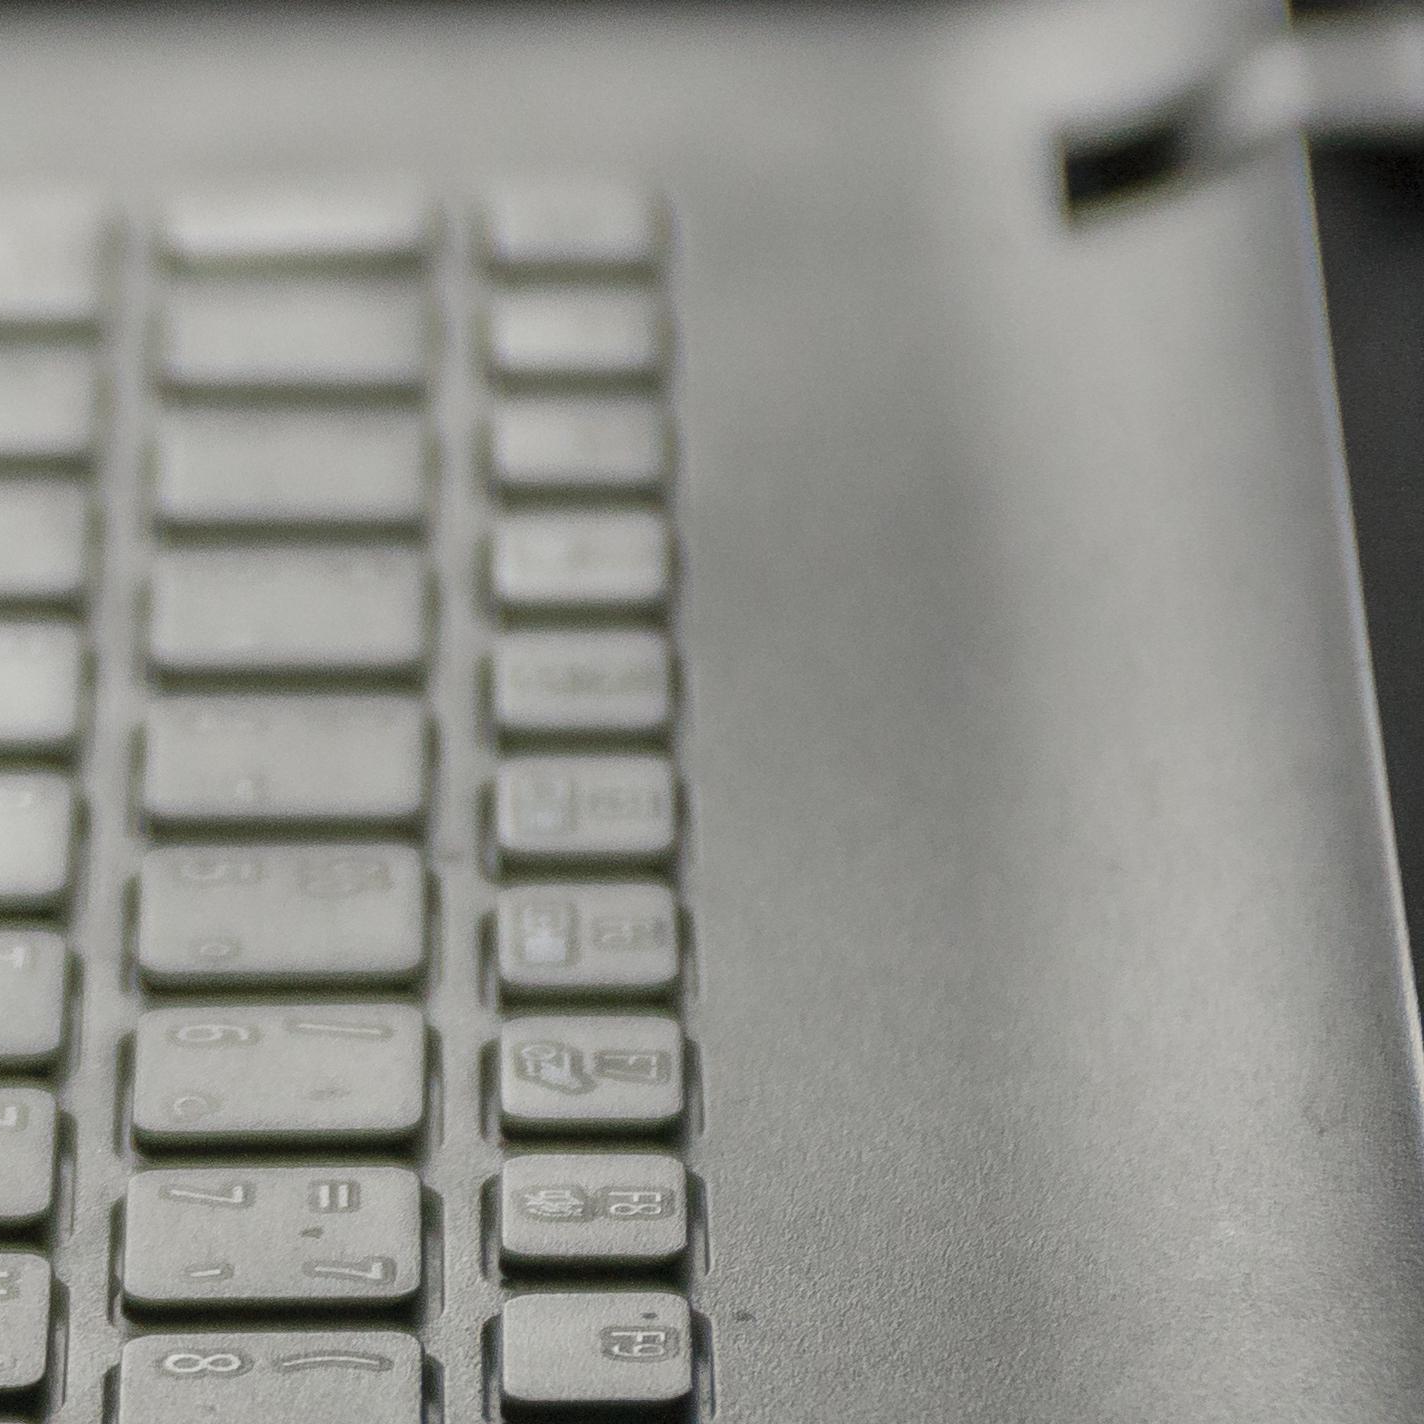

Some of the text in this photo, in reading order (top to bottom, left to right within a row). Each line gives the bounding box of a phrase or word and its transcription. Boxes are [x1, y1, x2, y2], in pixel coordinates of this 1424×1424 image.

[177, 1023, 249, 1042] 6
[604, 1054, 659, 1080] F7
[169, 1184, 245, 1205] 7
[318, 1182, 349, 1210] =
[609, 1190, 662, 1216] F8
[314, 1260, 384, 1280] 7
[612, 1330, 667, 1358] F9
[163, 1352, 242, 1374] 8
[279, 1355, 381, 1368] (
